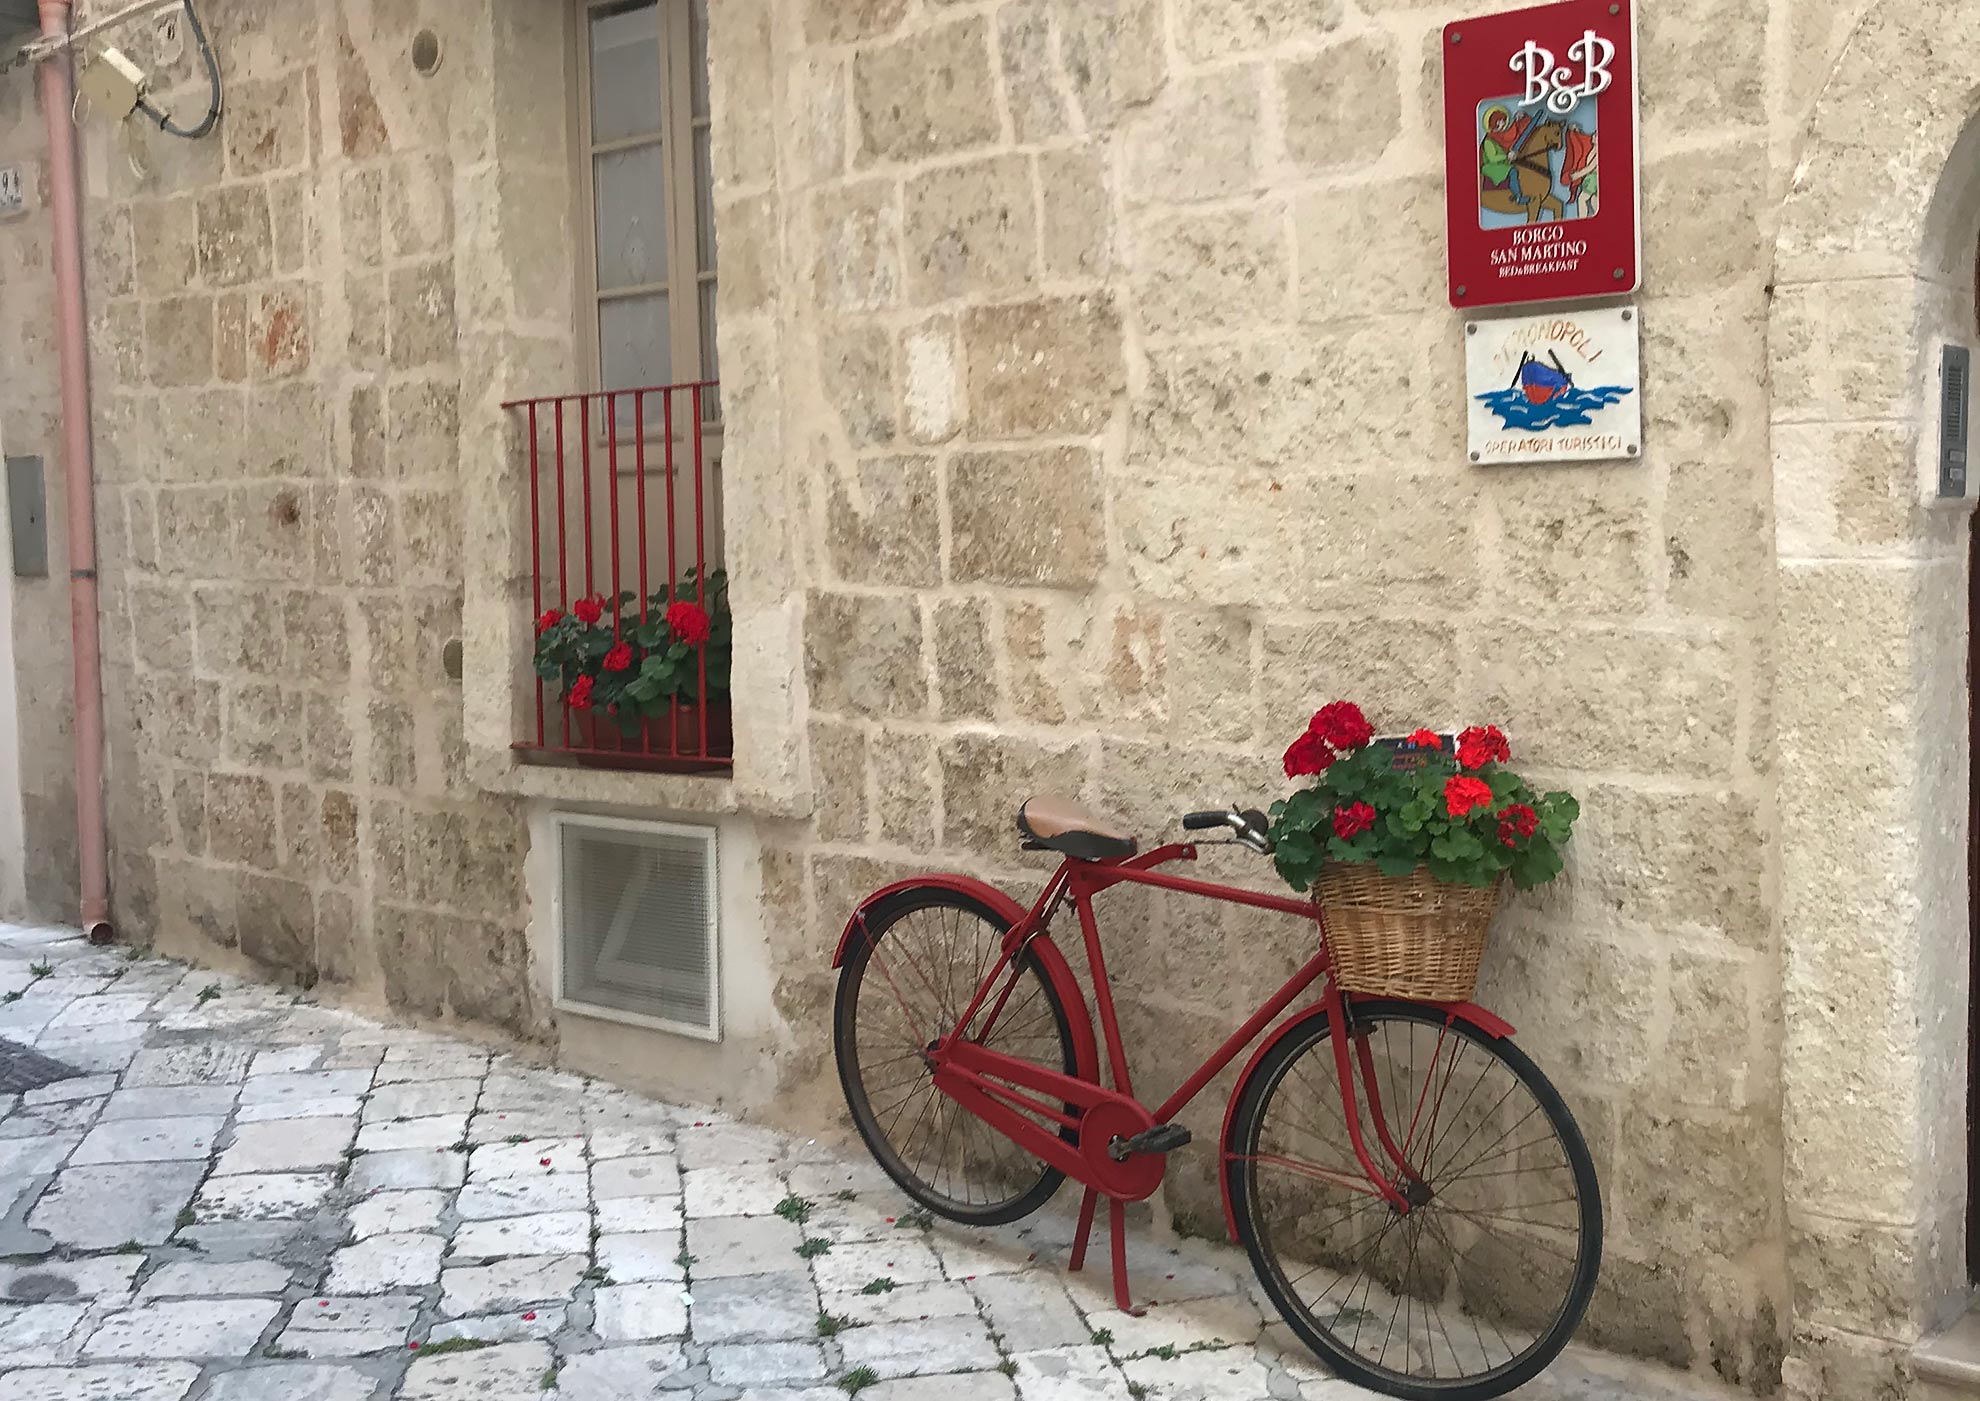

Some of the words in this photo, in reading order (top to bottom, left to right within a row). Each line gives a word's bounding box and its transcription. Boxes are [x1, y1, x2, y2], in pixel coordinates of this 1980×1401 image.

[1508, 30, 1615, 114] B&B
[1513, 226, 1563, 245] BORGO
[1491, 248, 1517, 265] SAN
[1522, 240, 1587, 261] MARTINO
[1557, 435, 1621, 451] TURISTICI
